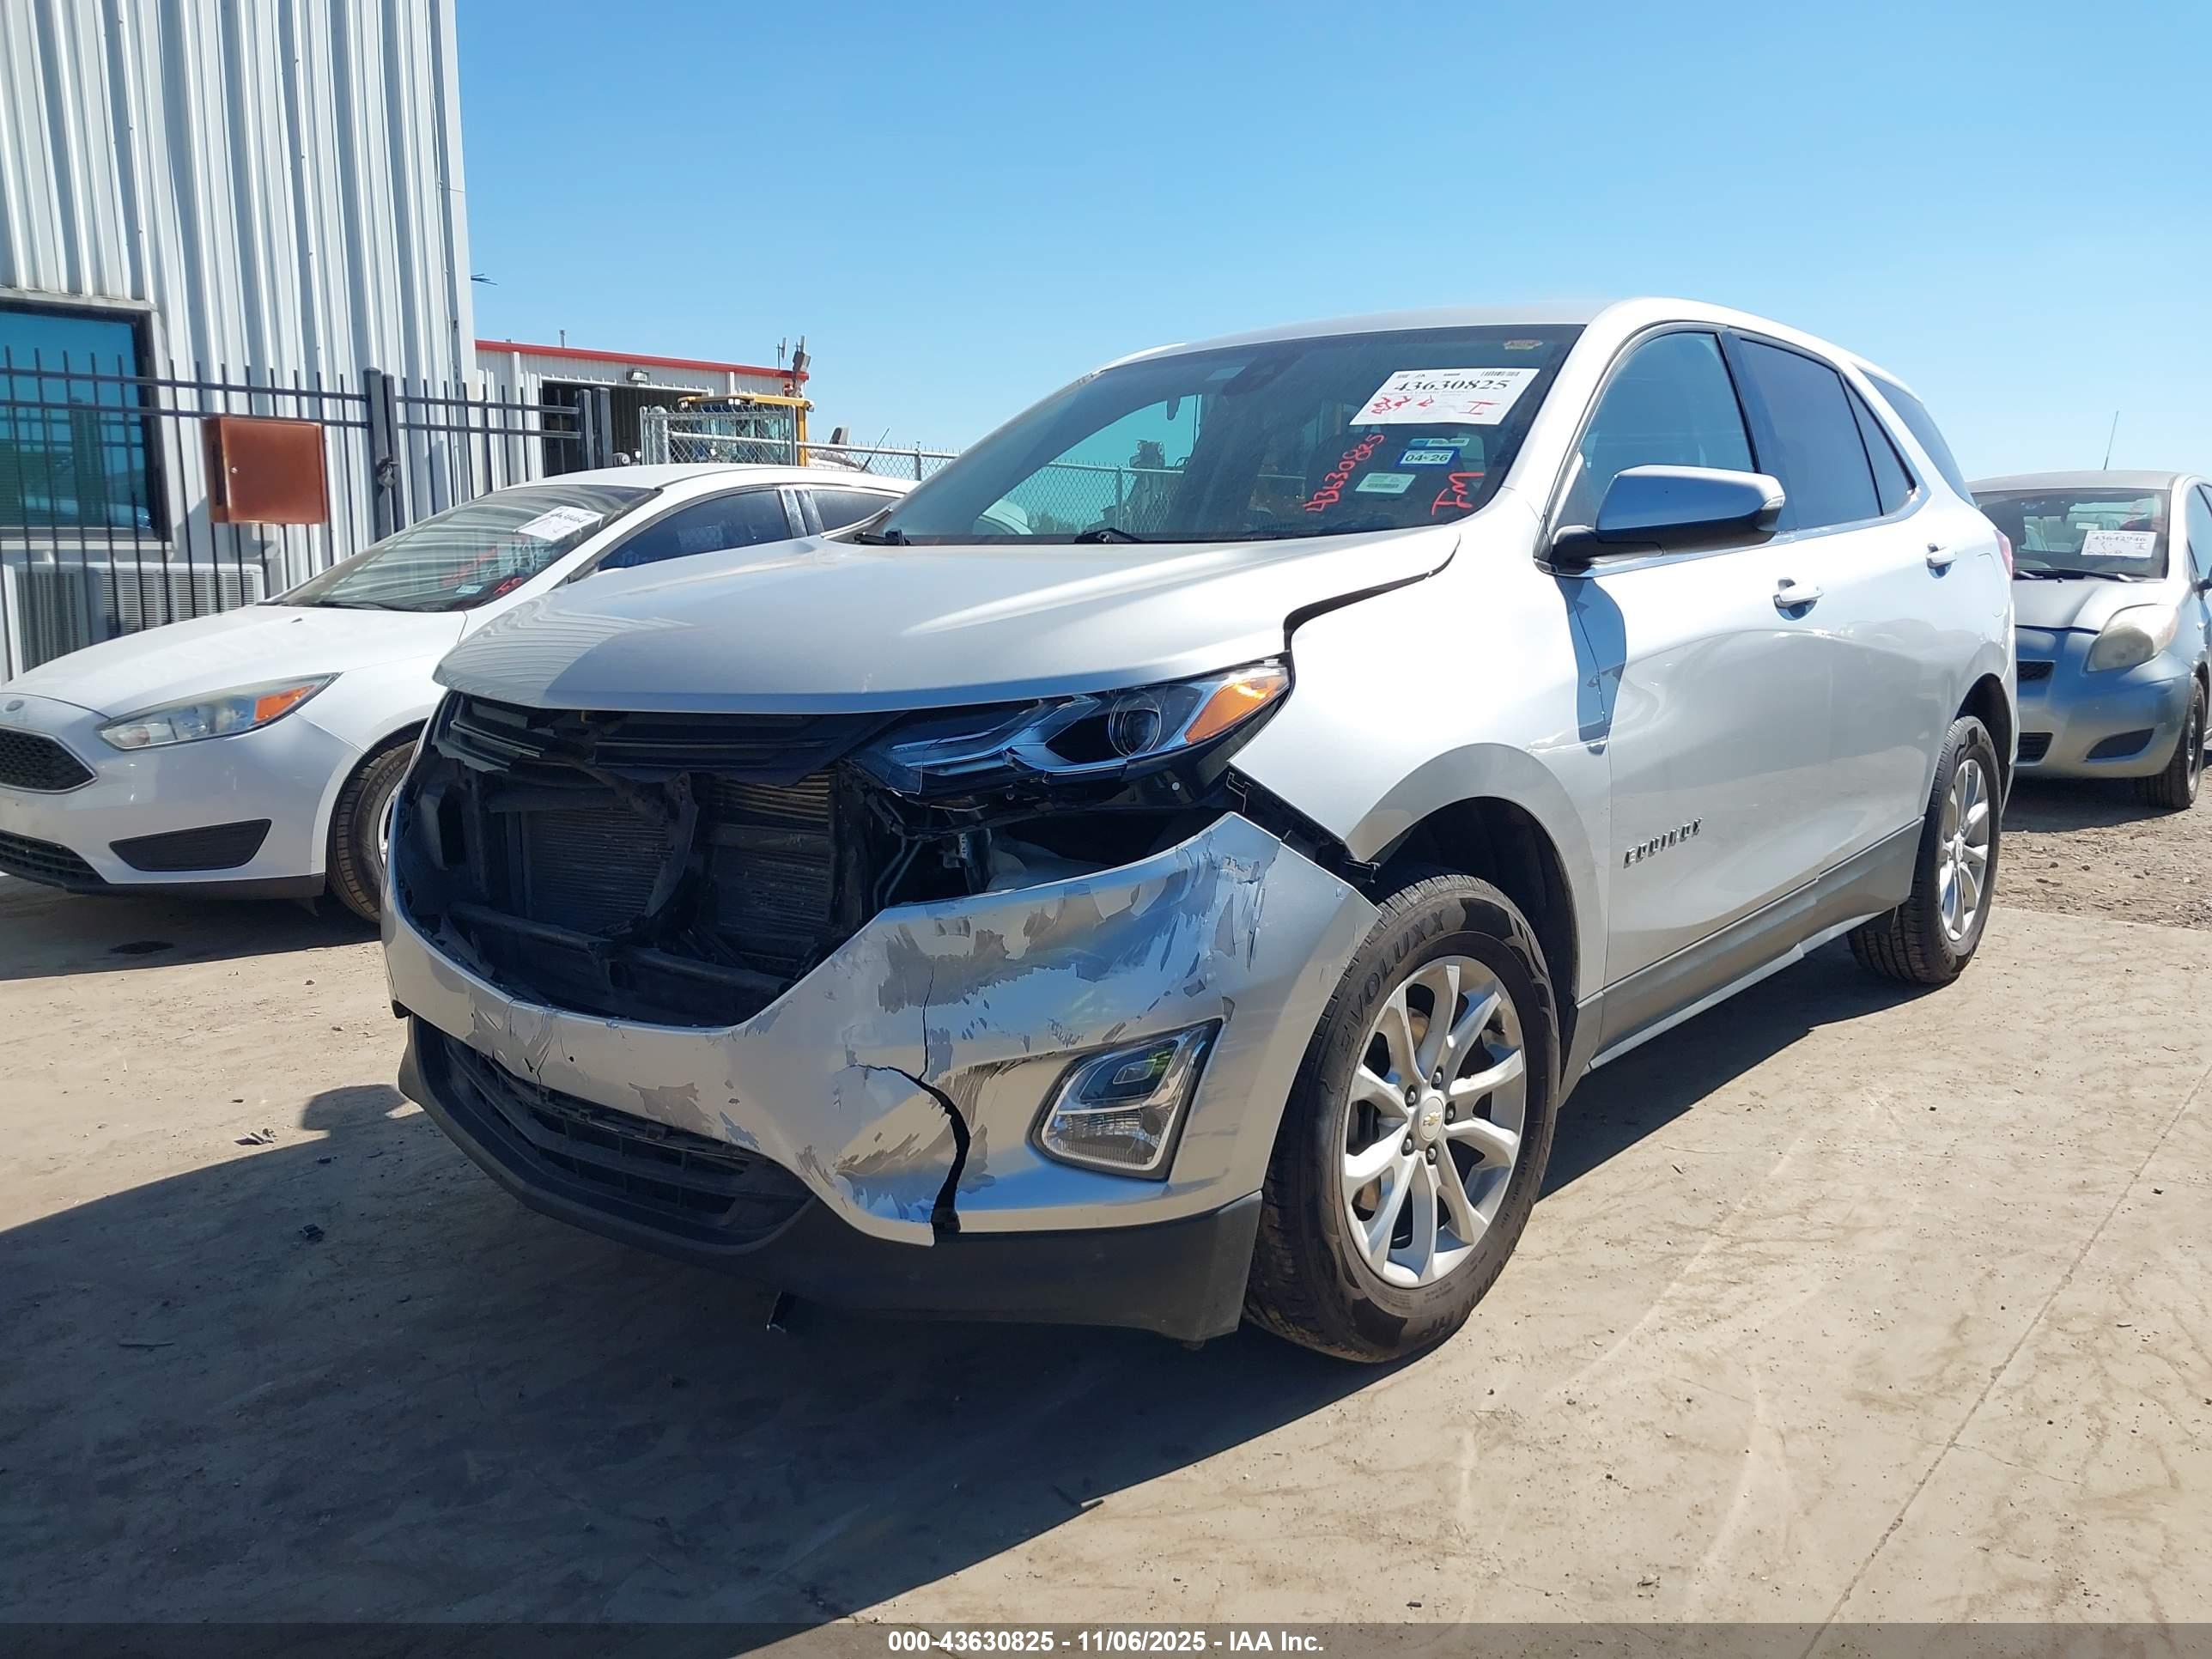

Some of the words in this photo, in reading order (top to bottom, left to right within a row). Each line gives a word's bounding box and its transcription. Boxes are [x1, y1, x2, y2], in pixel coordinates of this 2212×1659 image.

[1395, 380, 1511, 391] 43630825
[1623, 817, 1704, 869] EQUINOX
[1340, 908, 1445, 1054] EVOLUXX
